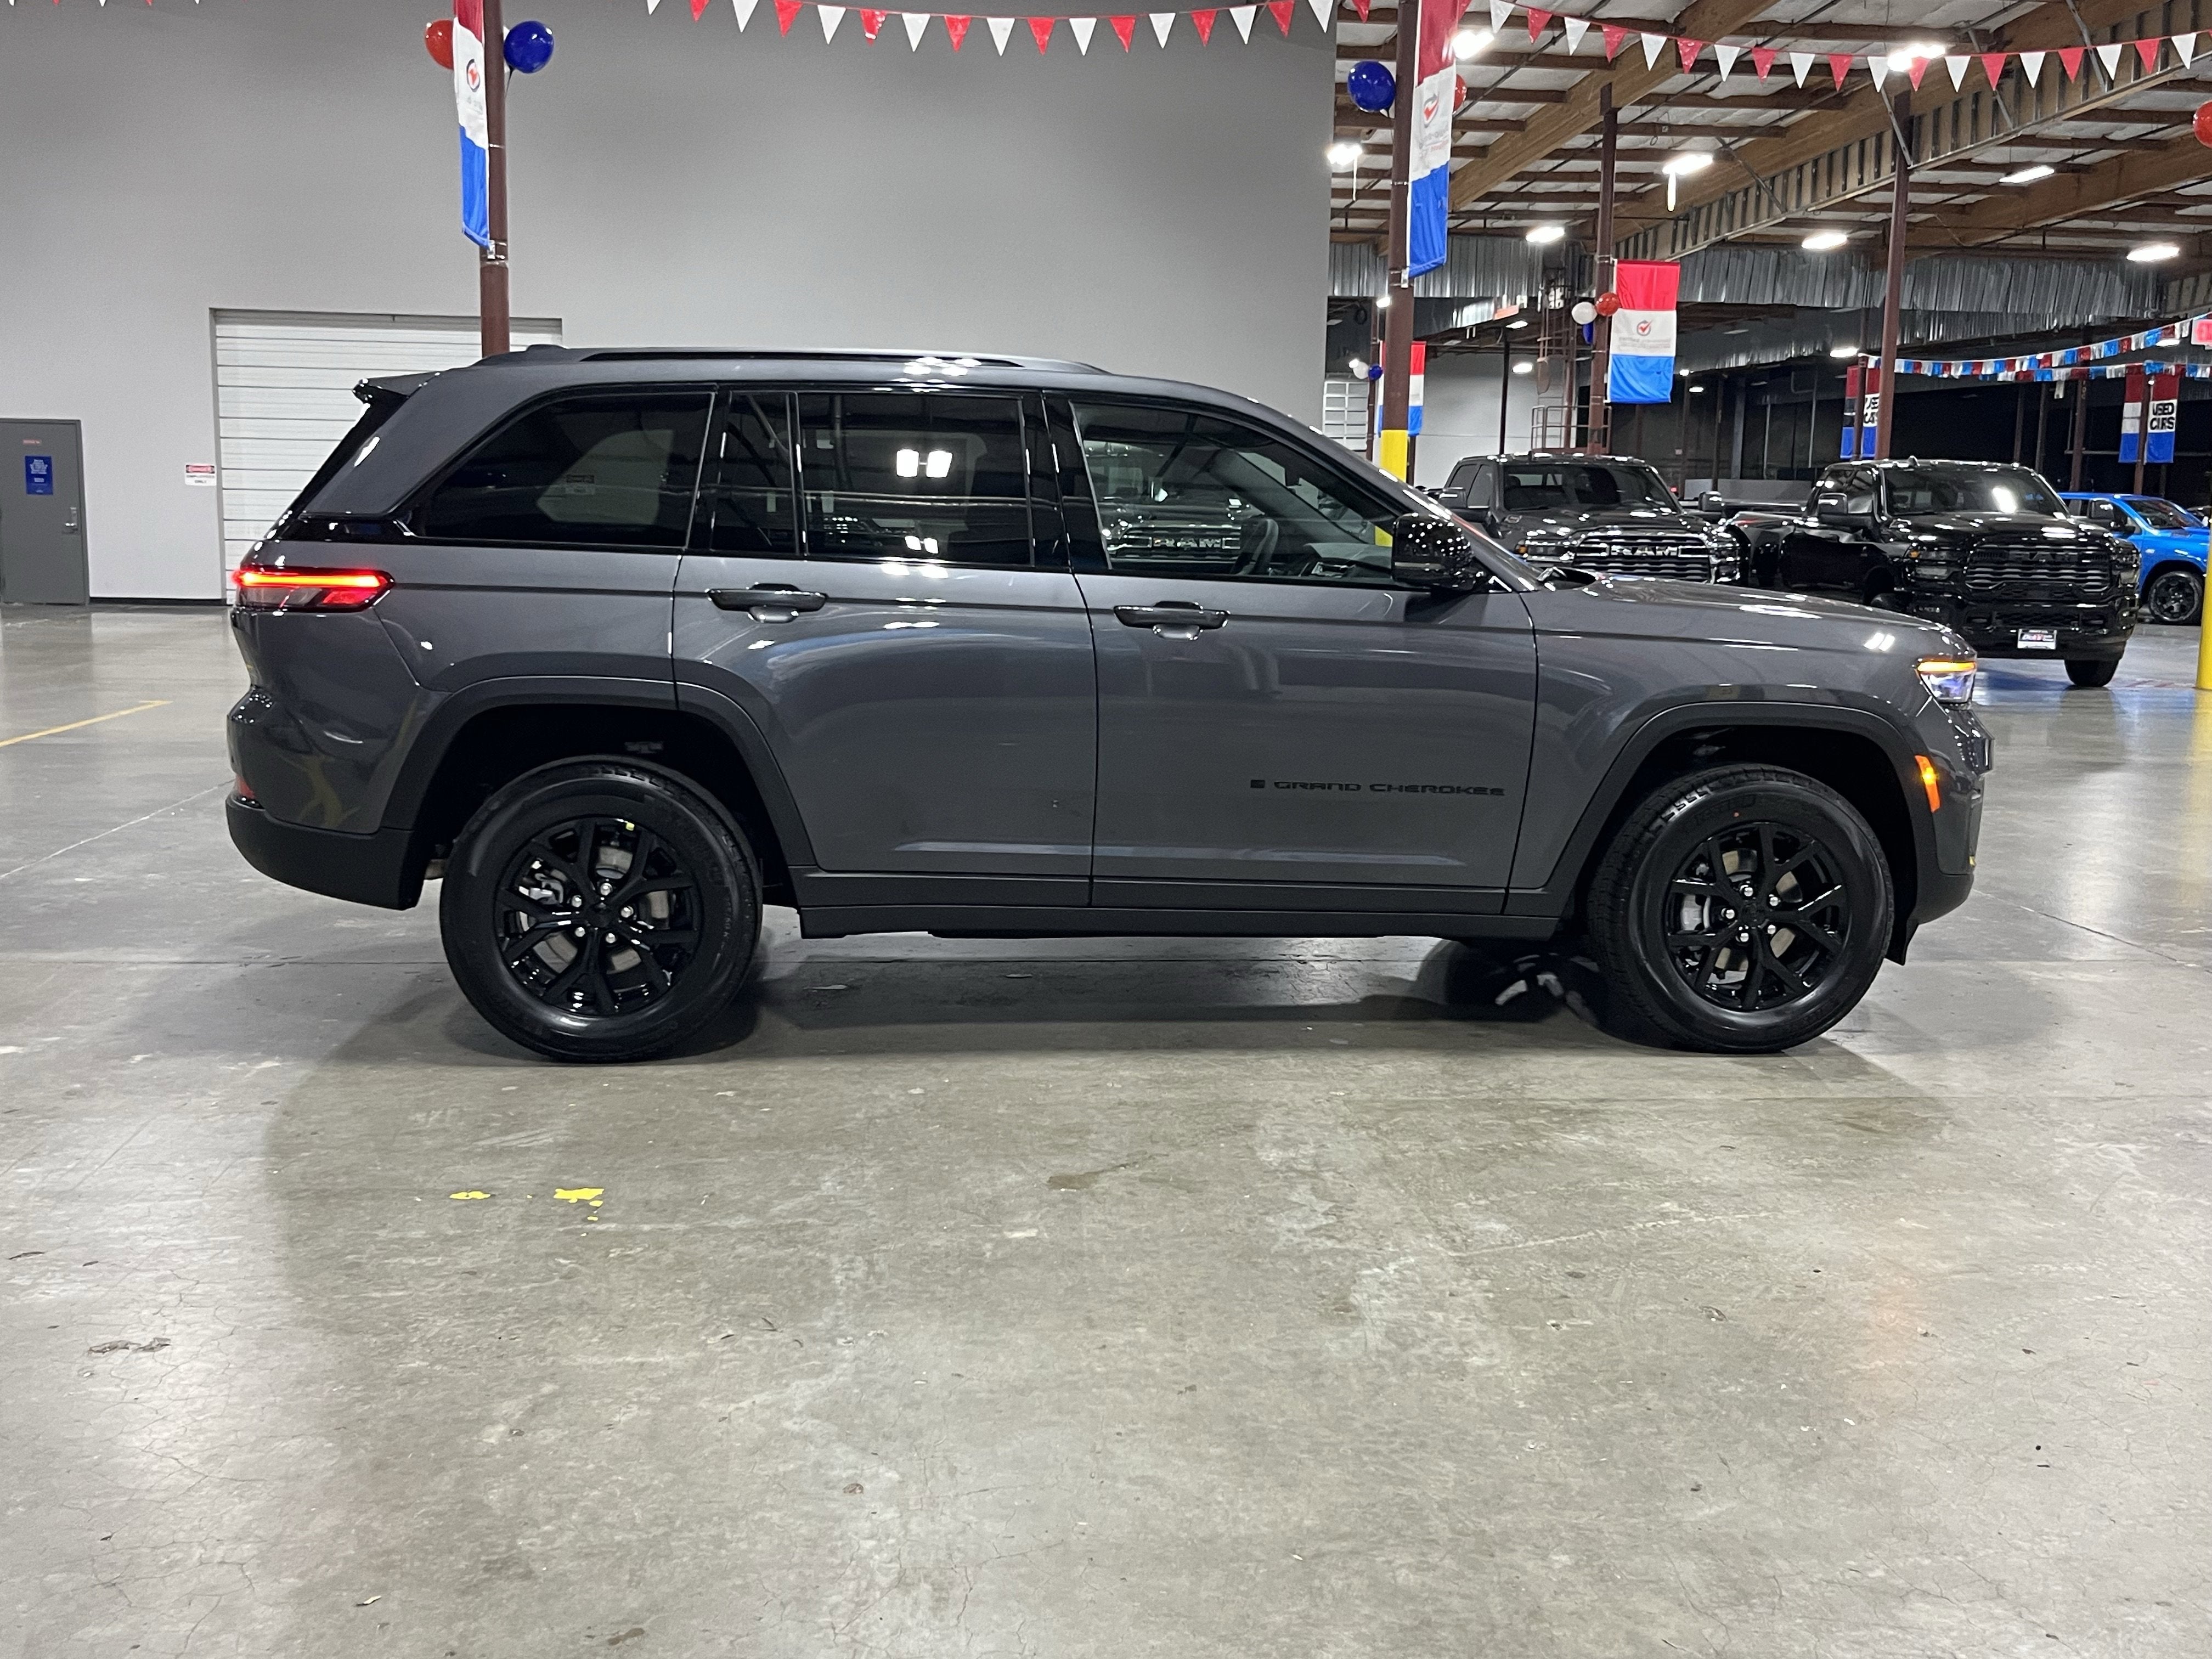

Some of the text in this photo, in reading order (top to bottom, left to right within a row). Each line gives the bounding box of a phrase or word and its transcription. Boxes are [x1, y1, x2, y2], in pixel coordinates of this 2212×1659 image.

[2153, 402, 2174, 416] USED
[1153, 538, 1221, 548] RAM
[1611, 545, 1678, 556] RAM
[1274, 781, 1505, 795] GRAND CHEROKEE
